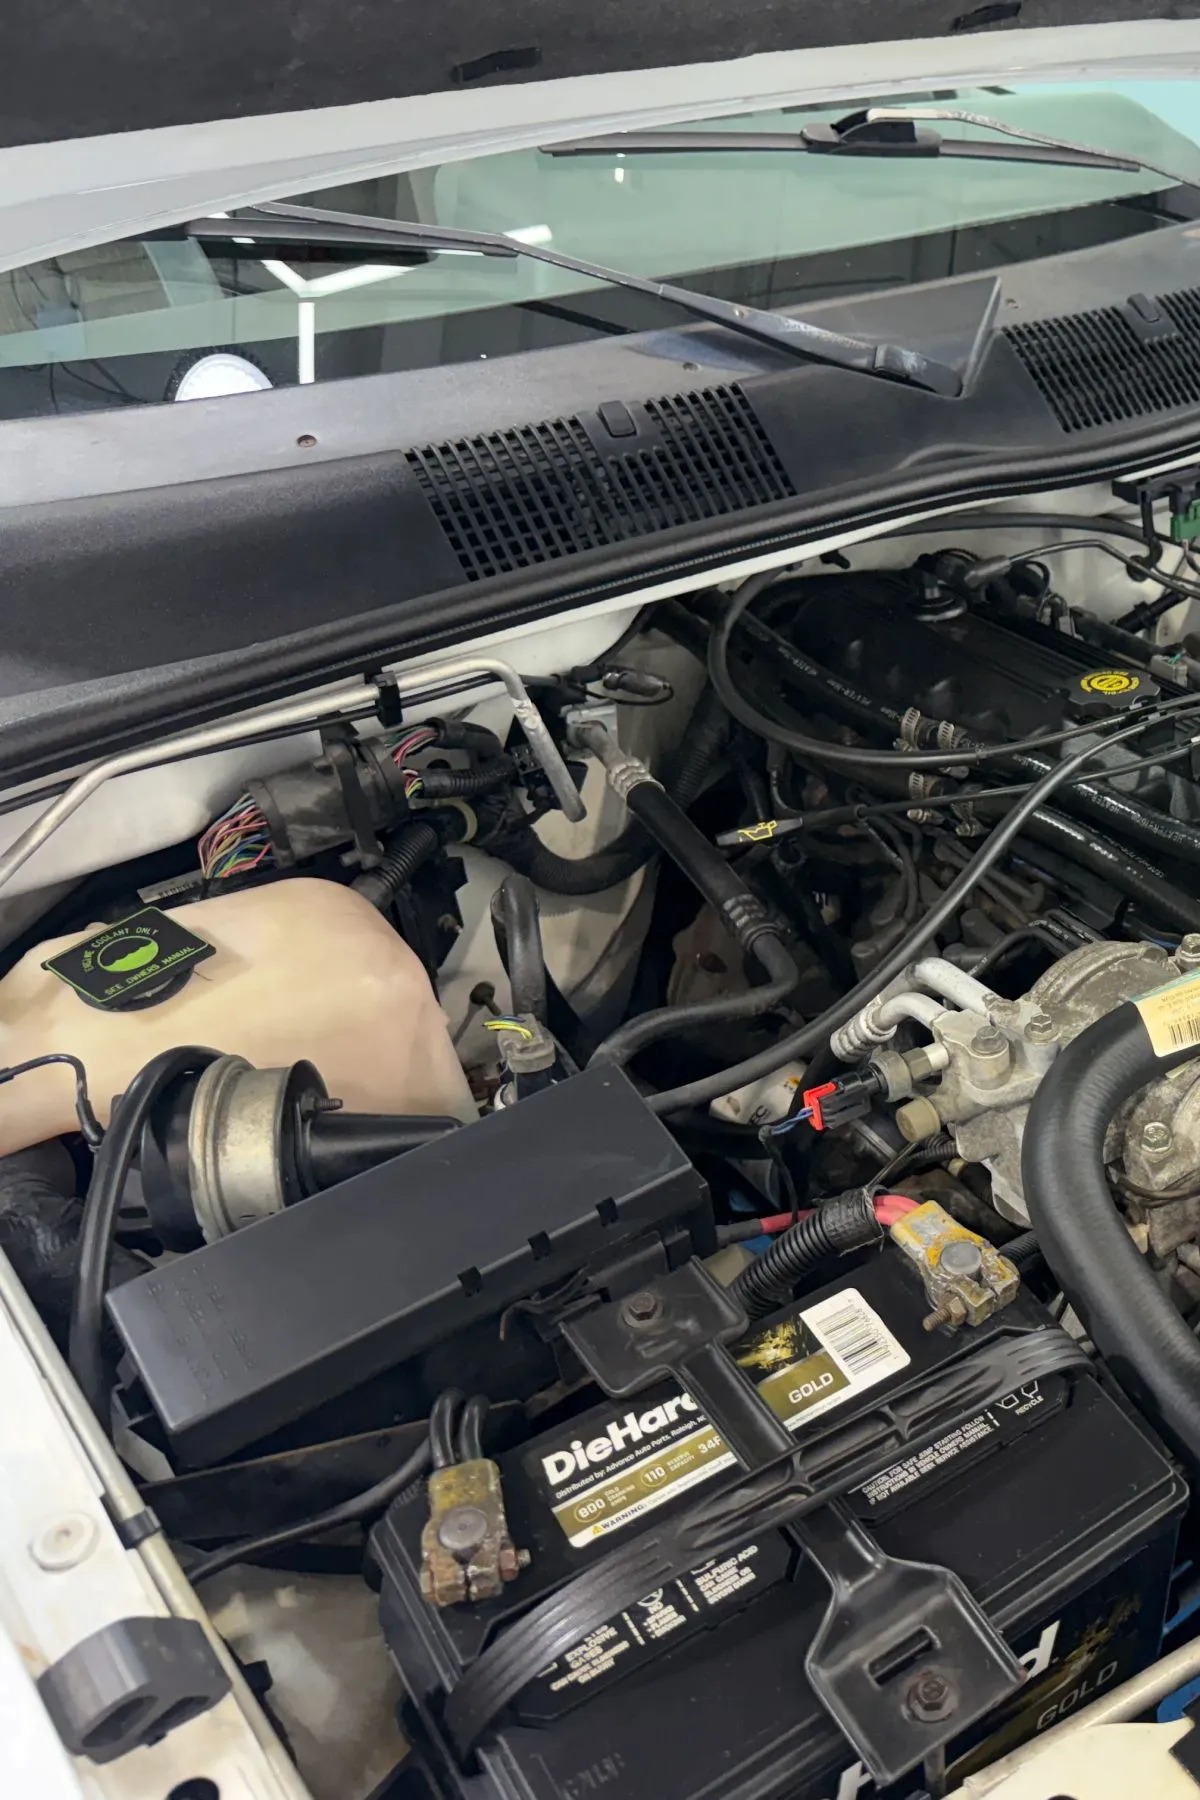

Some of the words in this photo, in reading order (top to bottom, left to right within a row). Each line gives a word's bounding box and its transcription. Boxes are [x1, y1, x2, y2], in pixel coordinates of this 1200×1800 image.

[104, 983, 124, 997] SEE
[125, 963, 161, 986] OWNERS
[161, 946, 196, 966] MANUAL
[788, 1371, 834, 1405] GOLD
[1015, 1394, 1043, 1415] RECYCLE
[866, 1469, 908, 1499] INSTRUCTIONS
[915, 1450, 939, 1469] VEHICLE
[938, 1435, 964, 1454] OWNERS
[888, 1464, 903, 1477] FOR
[901, 1455, 918, 1469] SAFE
[933, 1428, 961, 1449] STARTING
[961, 1414, 984, 1432] FOLLOW
[555, 1474, 594, 1500] Distributed
[605, 1452, 634, 1472] Advance
[634, 1443, 651, 1457] Auto
[643, 1465, 665, 1484] 110
[875, 1488, 889, 1501] NOT
[889, 1470, 920, 1492] AVAILABLE
[934, 1445, 959, 1465] SERVICE
[577, 1497, 606, 1520] 800
[694, 1556, 738, 1586] SULFURIC
[736, 1543, 759, 1561] ACID
[563, 1625, 618, 1663] EXPLOSIVE
[568, 1644, 603, 1670] GASES
[1037, 1661, 1118, 1730] GOLD
